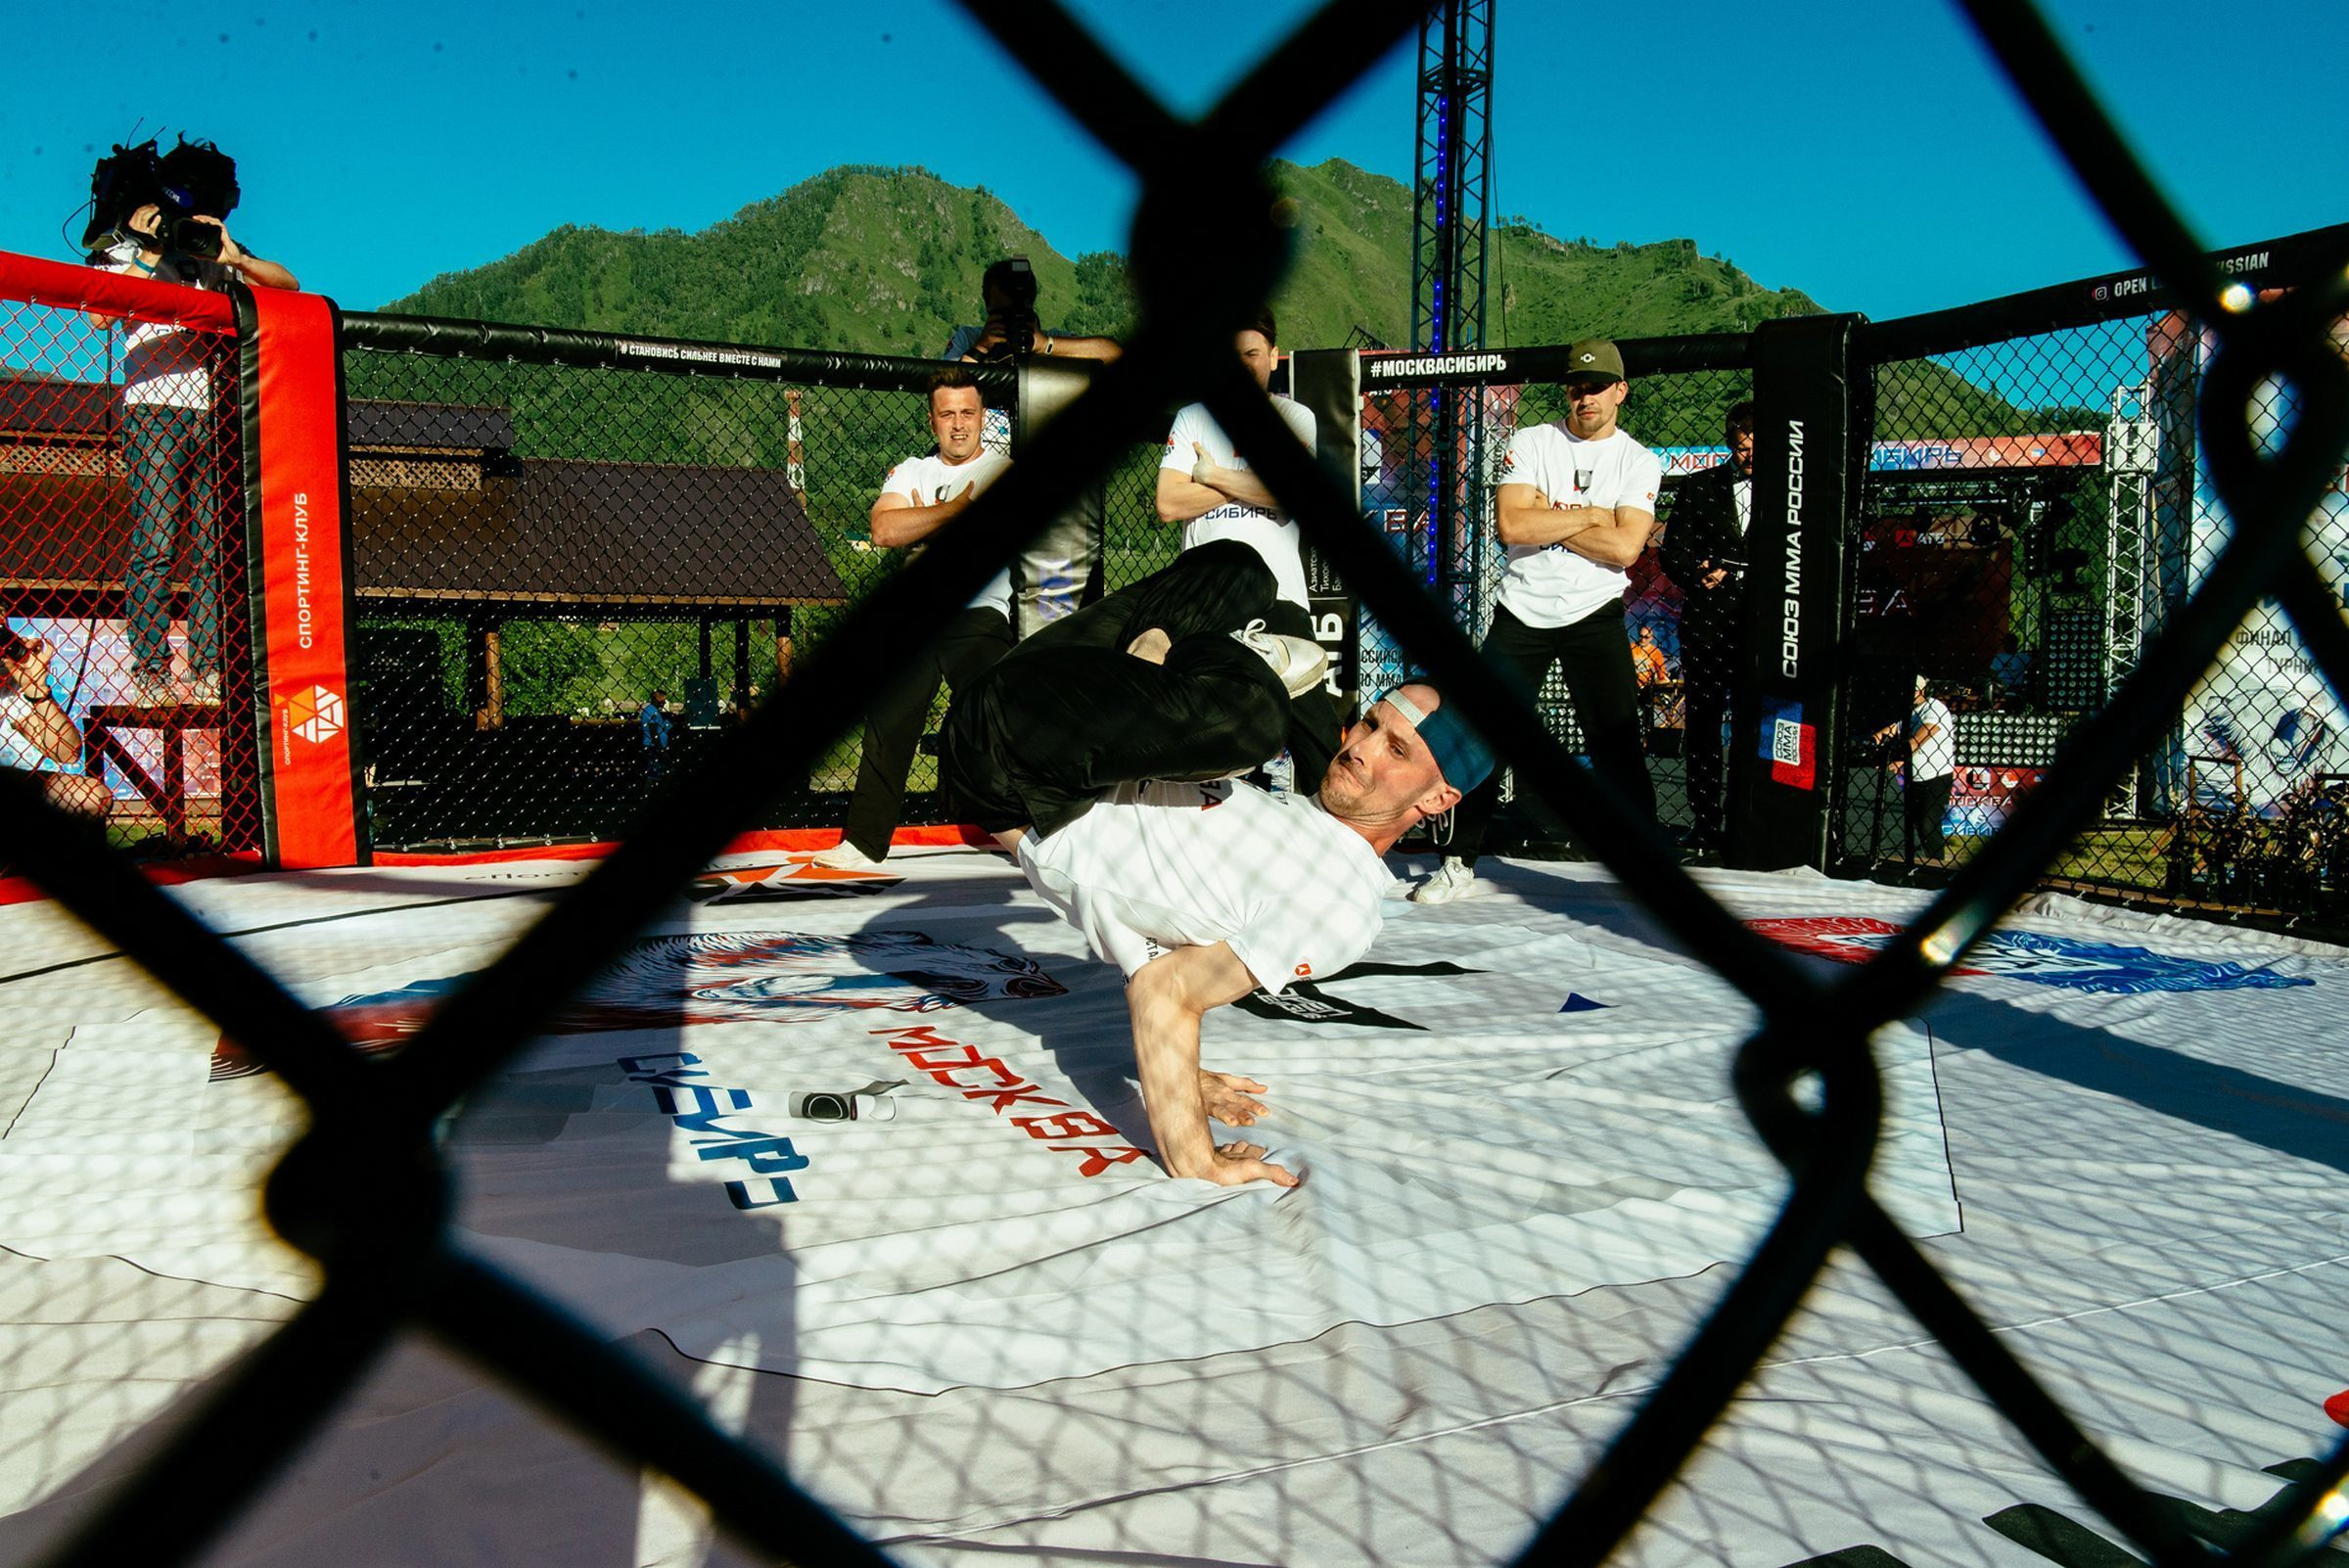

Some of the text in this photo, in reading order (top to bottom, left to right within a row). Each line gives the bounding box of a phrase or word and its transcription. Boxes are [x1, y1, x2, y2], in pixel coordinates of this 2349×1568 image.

[629, 346, 679, 359] СТАНОВИСЬ
[680, 349, 717, 362] СИЛЬНЕЕ
[719, 352, 751, 366] ВМЕСТЕ
[751, 355, 758, 366] С
[758, 355, 782, 368] НАМИ
[2114, 276, 2147, 298] OPEN
[1370, 354, 1507, 378] #МОСКВАСИБИРЬ
[295, 491, 313, 649] СПОРТИНГ-КЛУБ
[1781, 420, 1804, 679] СОЮЗ ММА РОССИИ
[617, 1051, 810, 1210] СИБИРЬ
[867, 1025, 1153, 1178] МОСКВА
